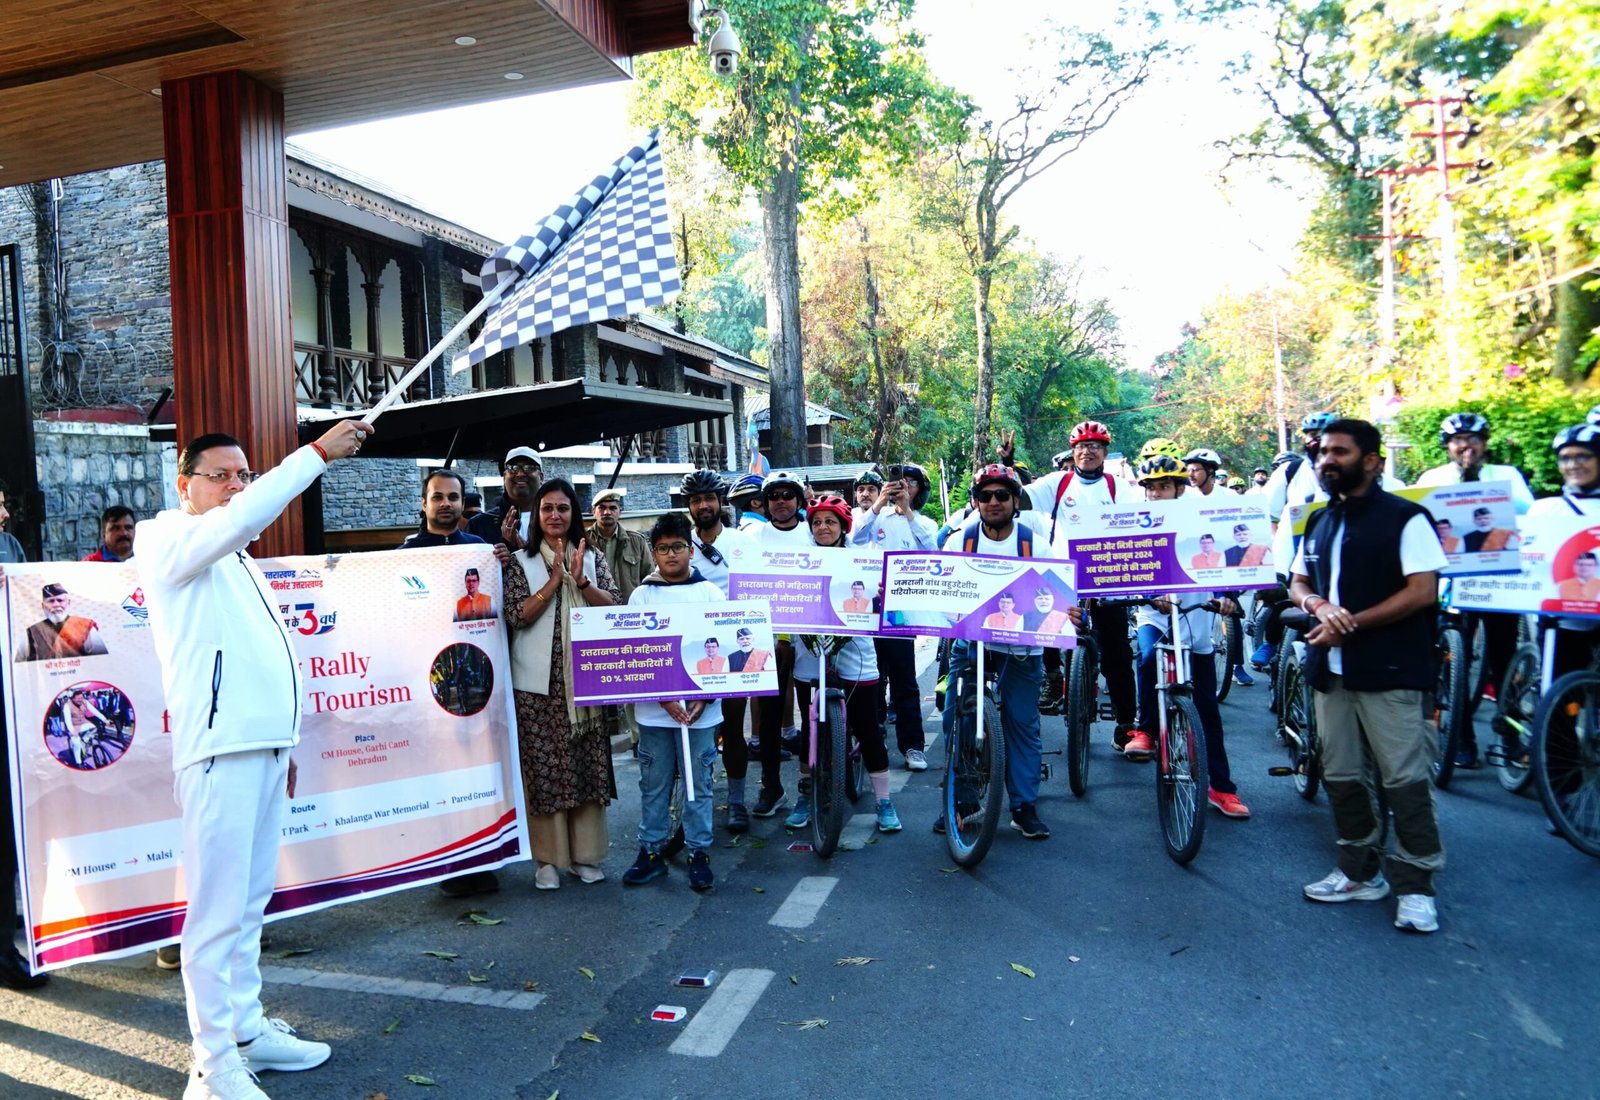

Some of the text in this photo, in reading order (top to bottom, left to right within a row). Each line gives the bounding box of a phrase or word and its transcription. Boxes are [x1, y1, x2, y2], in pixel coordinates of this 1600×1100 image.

[1138, 511, 1153, 528] 3
[798, 553, 811, 569] 3
[1134, 551, 1153, 559] 2024
[929, 559, 943, 576] 3
[271, 579, 323, 590] निर्भर उत्तराखण्ड
[775, 580, 785, 589] की
[894, 578, 924, 586] जमरानी
[891, 587, 928, 596] परियोजना
[941, 588, 959, 597] कार्य
[291, 616, 300, 627] के
[295, 603, 318, 635] 3
[320, 611, 337, 625] वर्ष
[644, 611, 658, 630] 3
[659, 617, 671, 625] वर्ष
[580, 643, 672, 657] उत्तराखण्ड की महिलाओं
[309, 651, 372, 679] Rally
[580, 661, 593, 671] को
[594, 660, 626, 671] सरकारी
[665, 657, 674, 667] में
[601, 672, 655, 683] 30 % आरक्षण
[309, 684, 413, 714] Tourism
[355, 734, 375, 743] Place
[321, 739, 410, 760] CM House, Garhi Cantt
[348, 754, 387, 767] Dehradun
[291, 804, 316, 814] Route
[83, 862, 117, 875] House
[146, 849, 173, 862] Malsi
[289, 824, 309, 835] Park
[335, 813, 373, 827] Khalanga
[374, 809, 390, 819] War
[392, 801, 430, 815] Memorial
[451, 793, 473, 804] Pared
